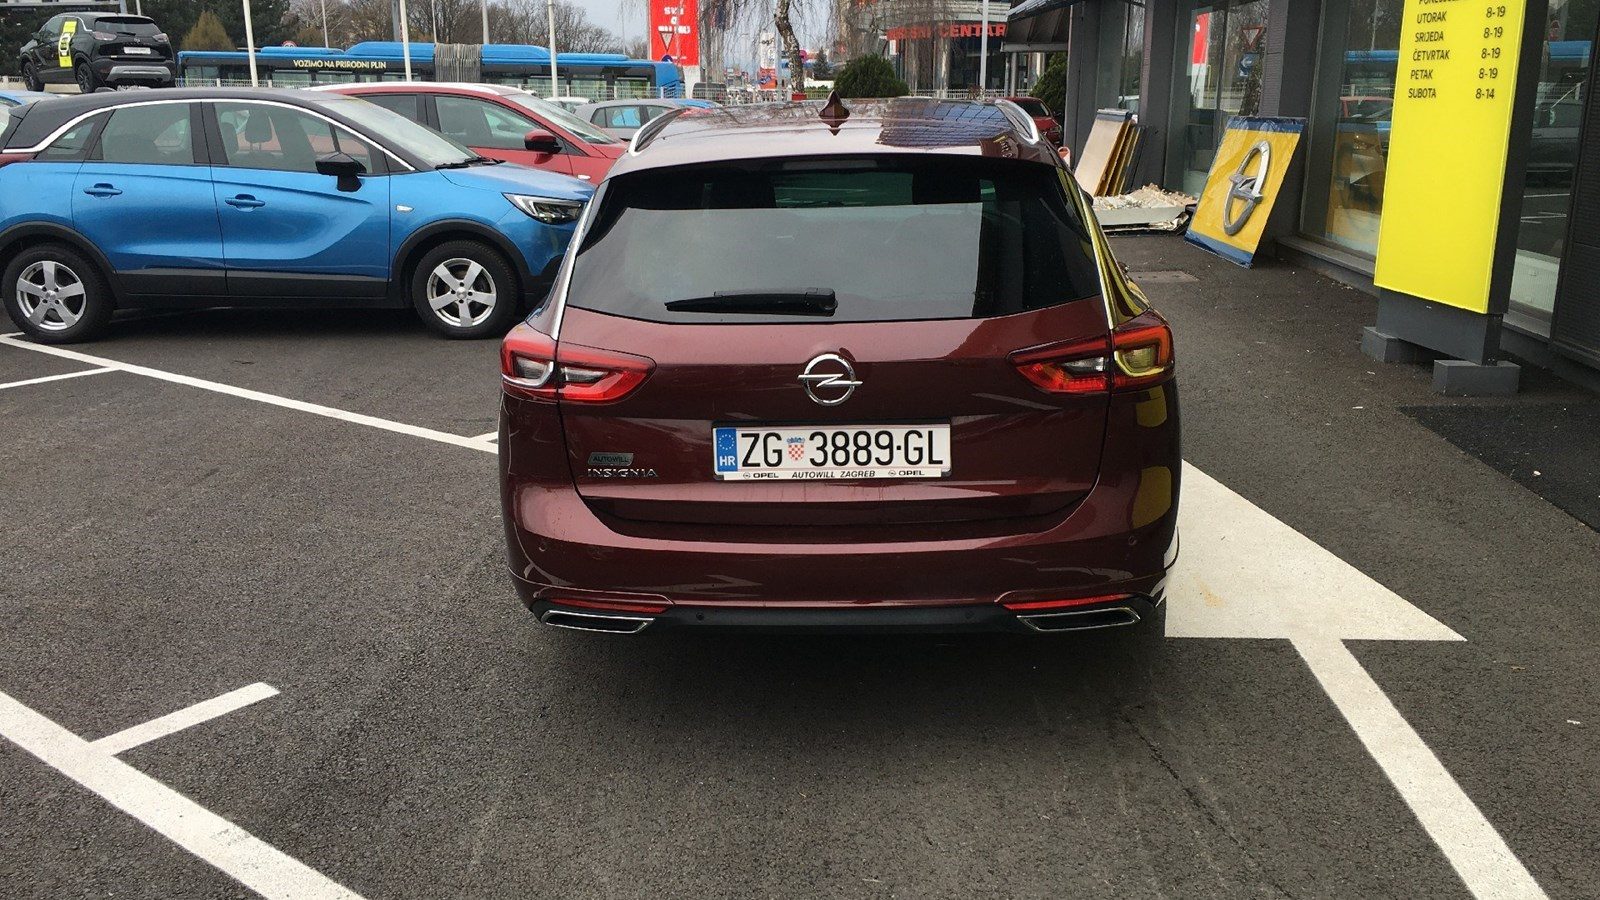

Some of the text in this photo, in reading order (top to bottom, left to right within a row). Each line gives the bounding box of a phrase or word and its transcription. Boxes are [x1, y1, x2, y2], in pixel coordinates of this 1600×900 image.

[1416, 6, 1506, 24] UTORAK 8-19
[1415, 27, 1503, 42] SRIJEDA 8-19
[1412, 47, 1501, 61] ČETVRTAK 8-19
[293, 60, 387, 69] VOZIMO NA PRIRODNI PLIN
[1410, 68, 1498, 79] PETAK 8-19
[1408, 88, 1495, 99] SUBOTA 8-14
[741, 432, 782, 467] ZG
[720, 456, 736, 466] HR
[587, 468, 659, 477] INSIGNIA
[791, 471, 835, 479] AUTOWILL
[840, 470, 875, 478] ZAGREB
